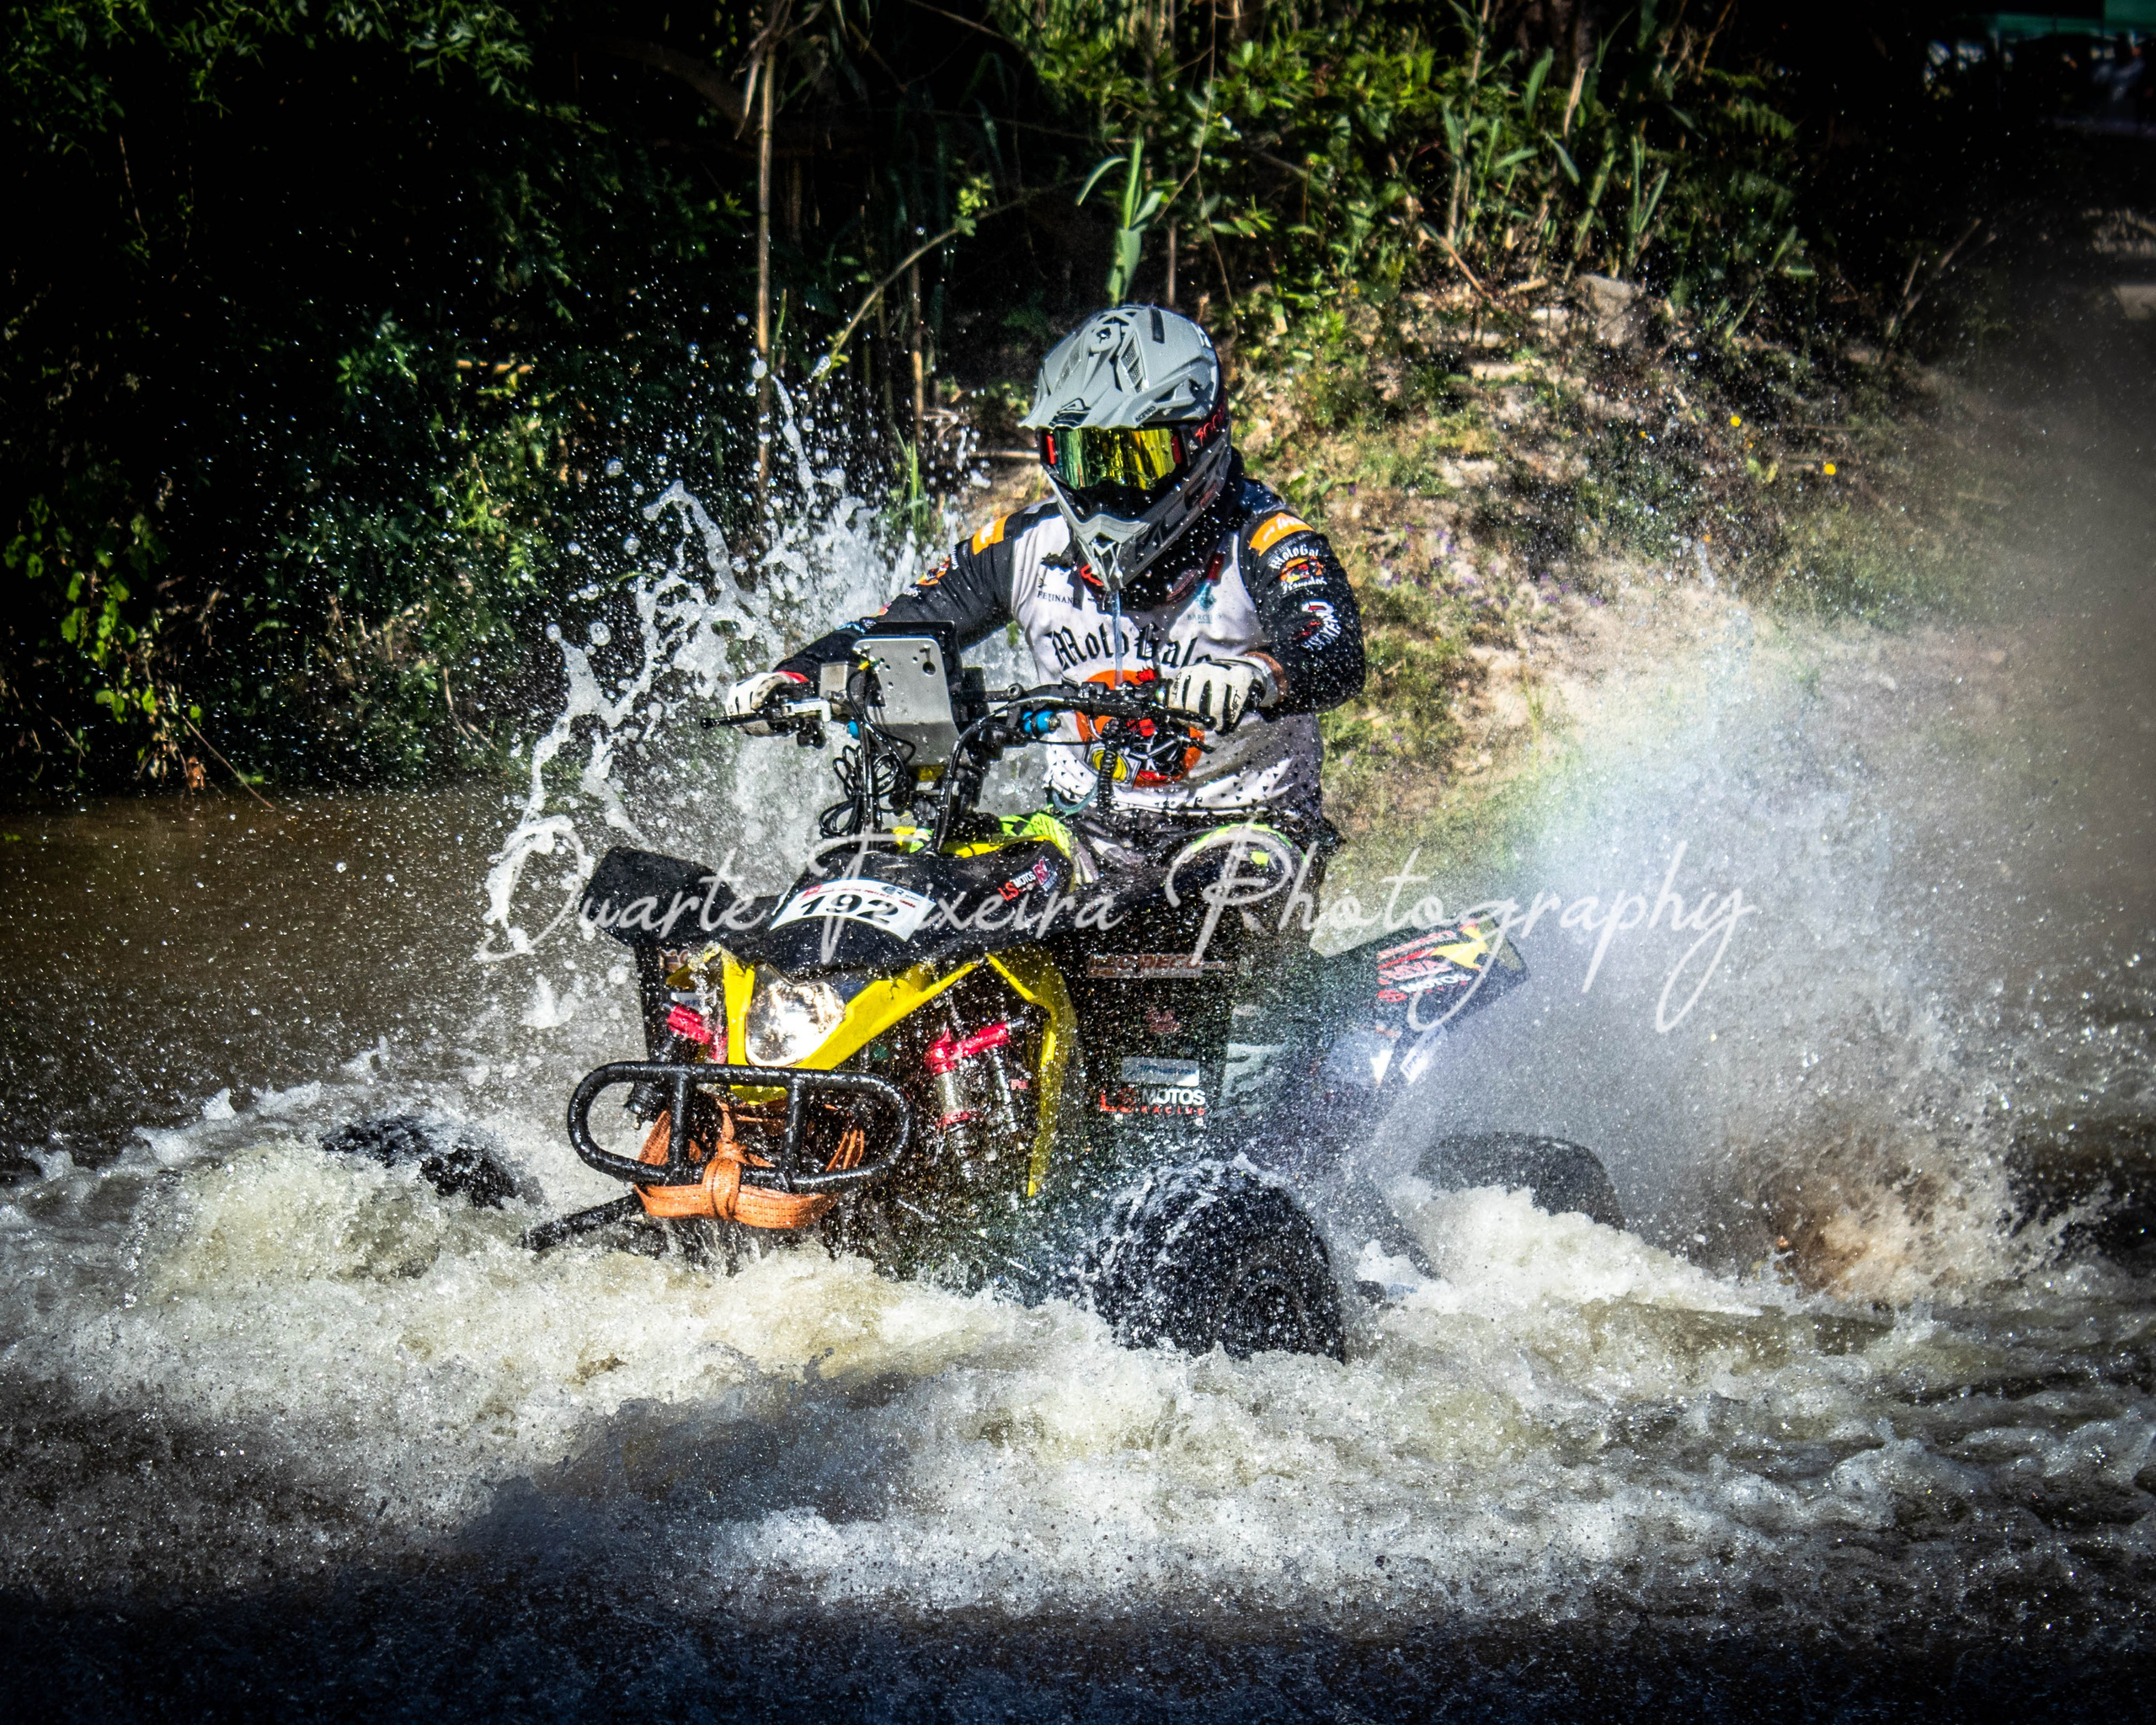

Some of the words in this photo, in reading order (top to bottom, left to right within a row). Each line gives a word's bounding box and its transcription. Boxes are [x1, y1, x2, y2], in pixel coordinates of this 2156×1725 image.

[998, 882, 1019, 901] LS
[1009, 870, 1037, 889] MOTOS
[801, 894, 899, 925] 192
[1100, 1087, 1135, 1114] LS
[1142, 1088, 1206, 1106] MOTOS
